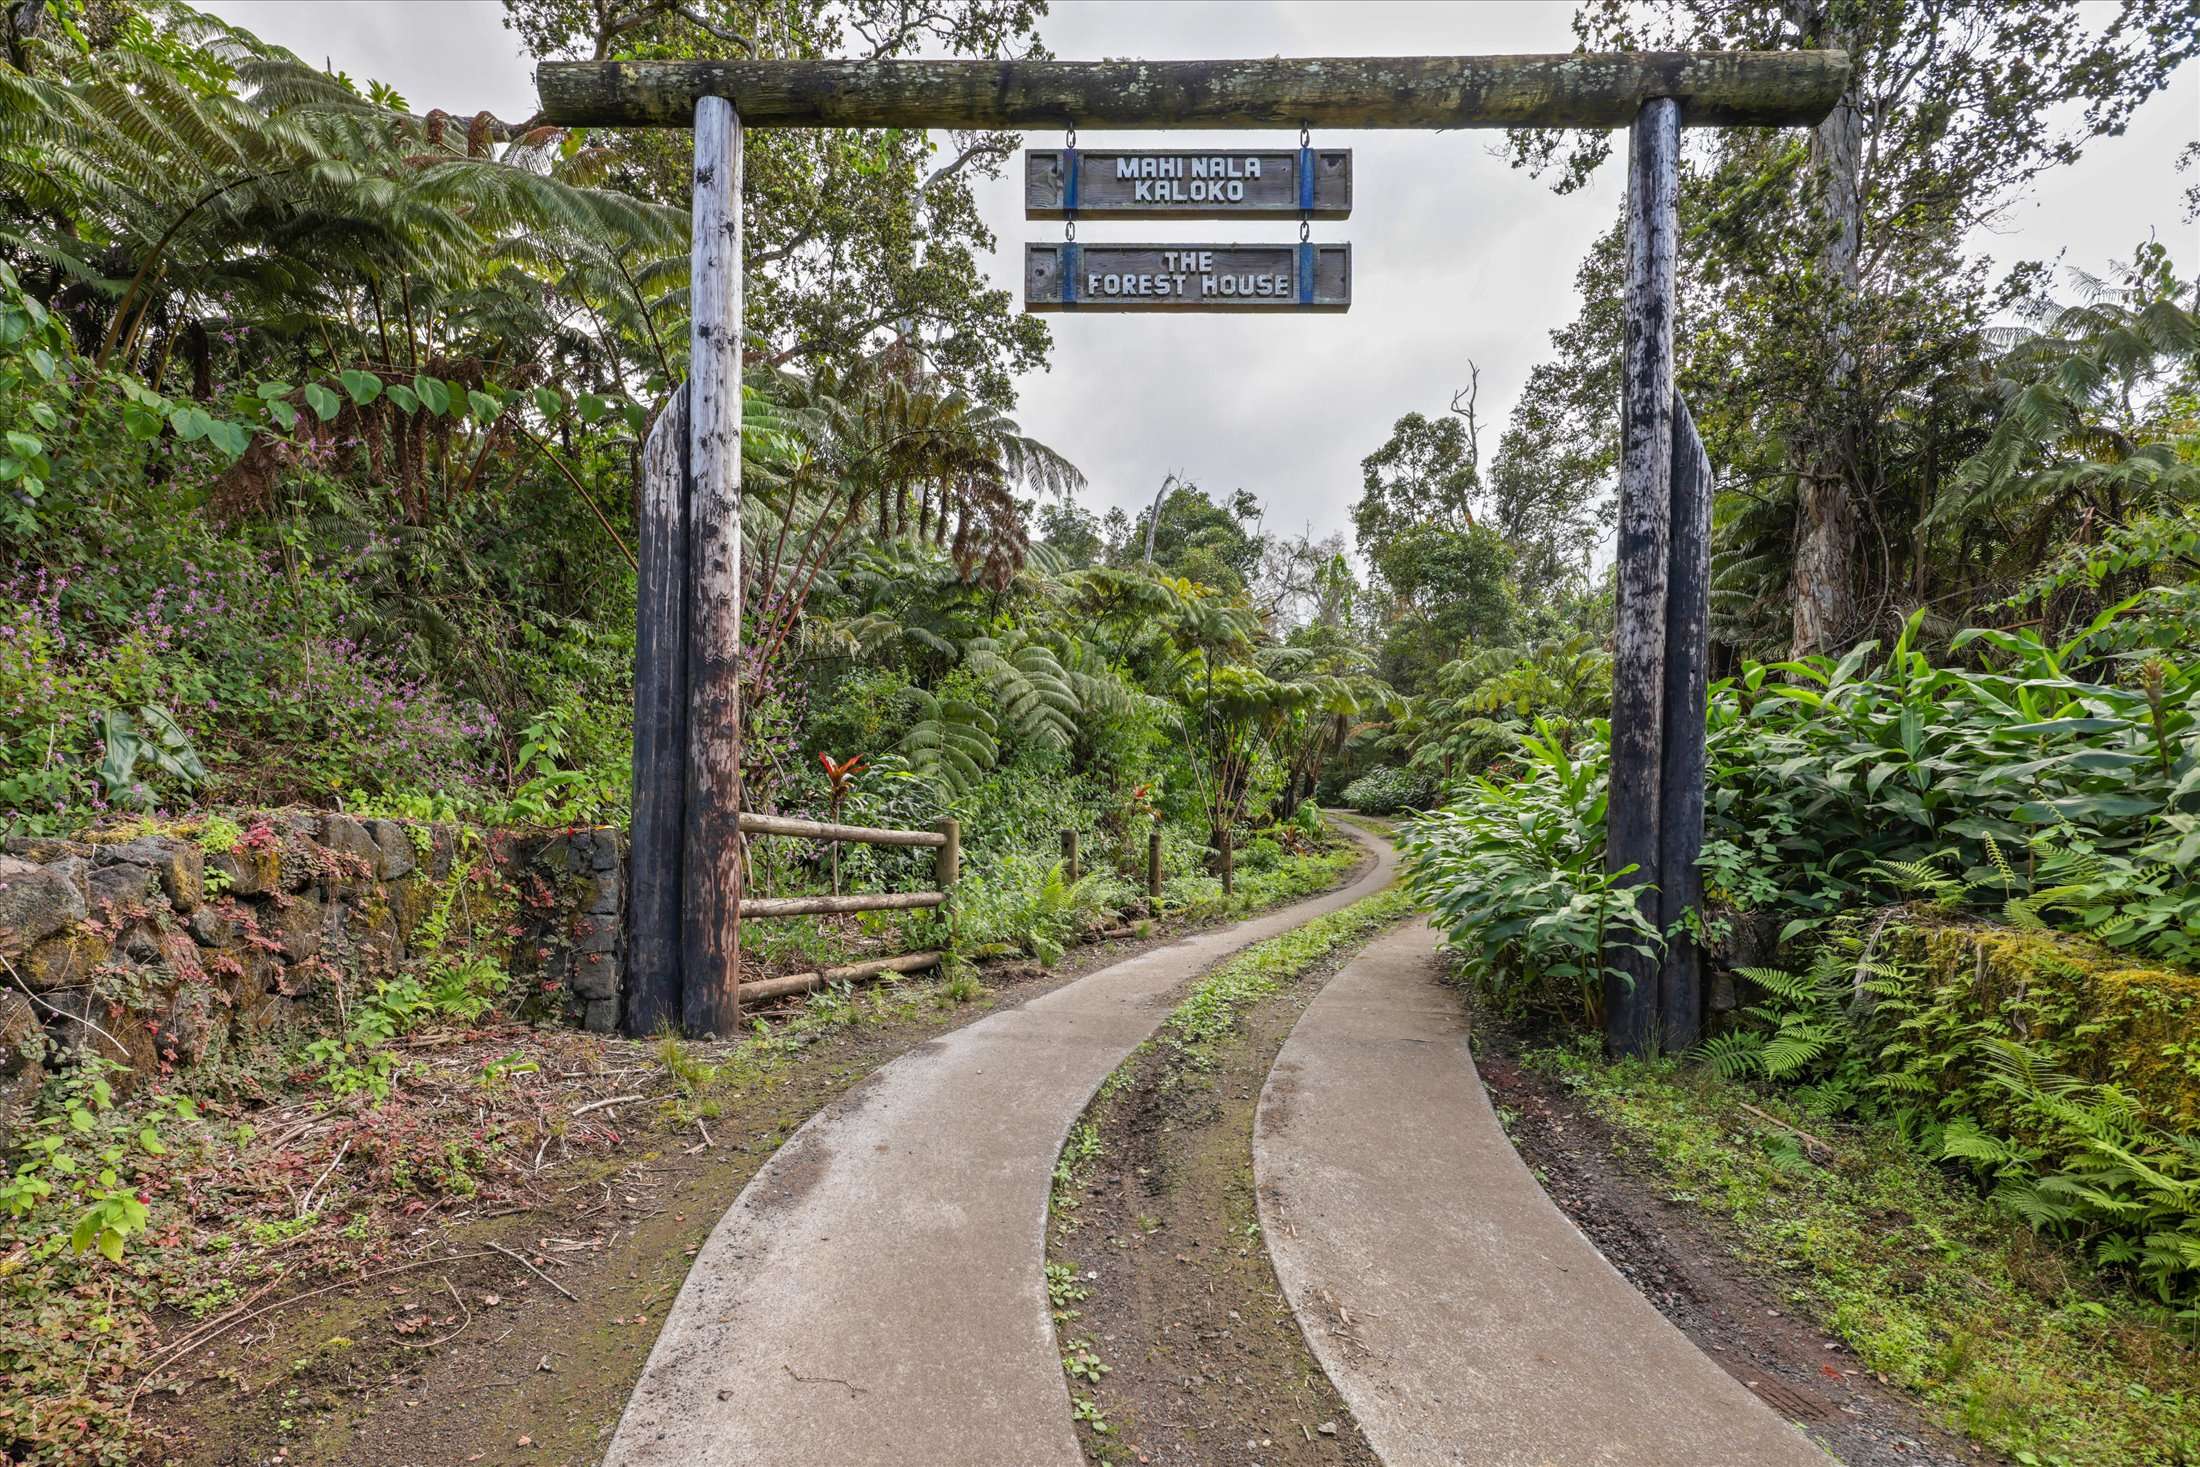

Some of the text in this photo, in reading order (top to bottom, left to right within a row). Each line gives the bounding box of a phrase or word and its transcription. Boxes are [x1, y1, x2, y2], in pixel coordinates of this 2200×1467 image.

[1117, 157, 1261, 178] MAHI NALA
[1135, 180, 1244, 202] KALOKO
[1165, 251, 1213, 272] THE
[1088, 274, 1289, 296] FOREST HOUSE
